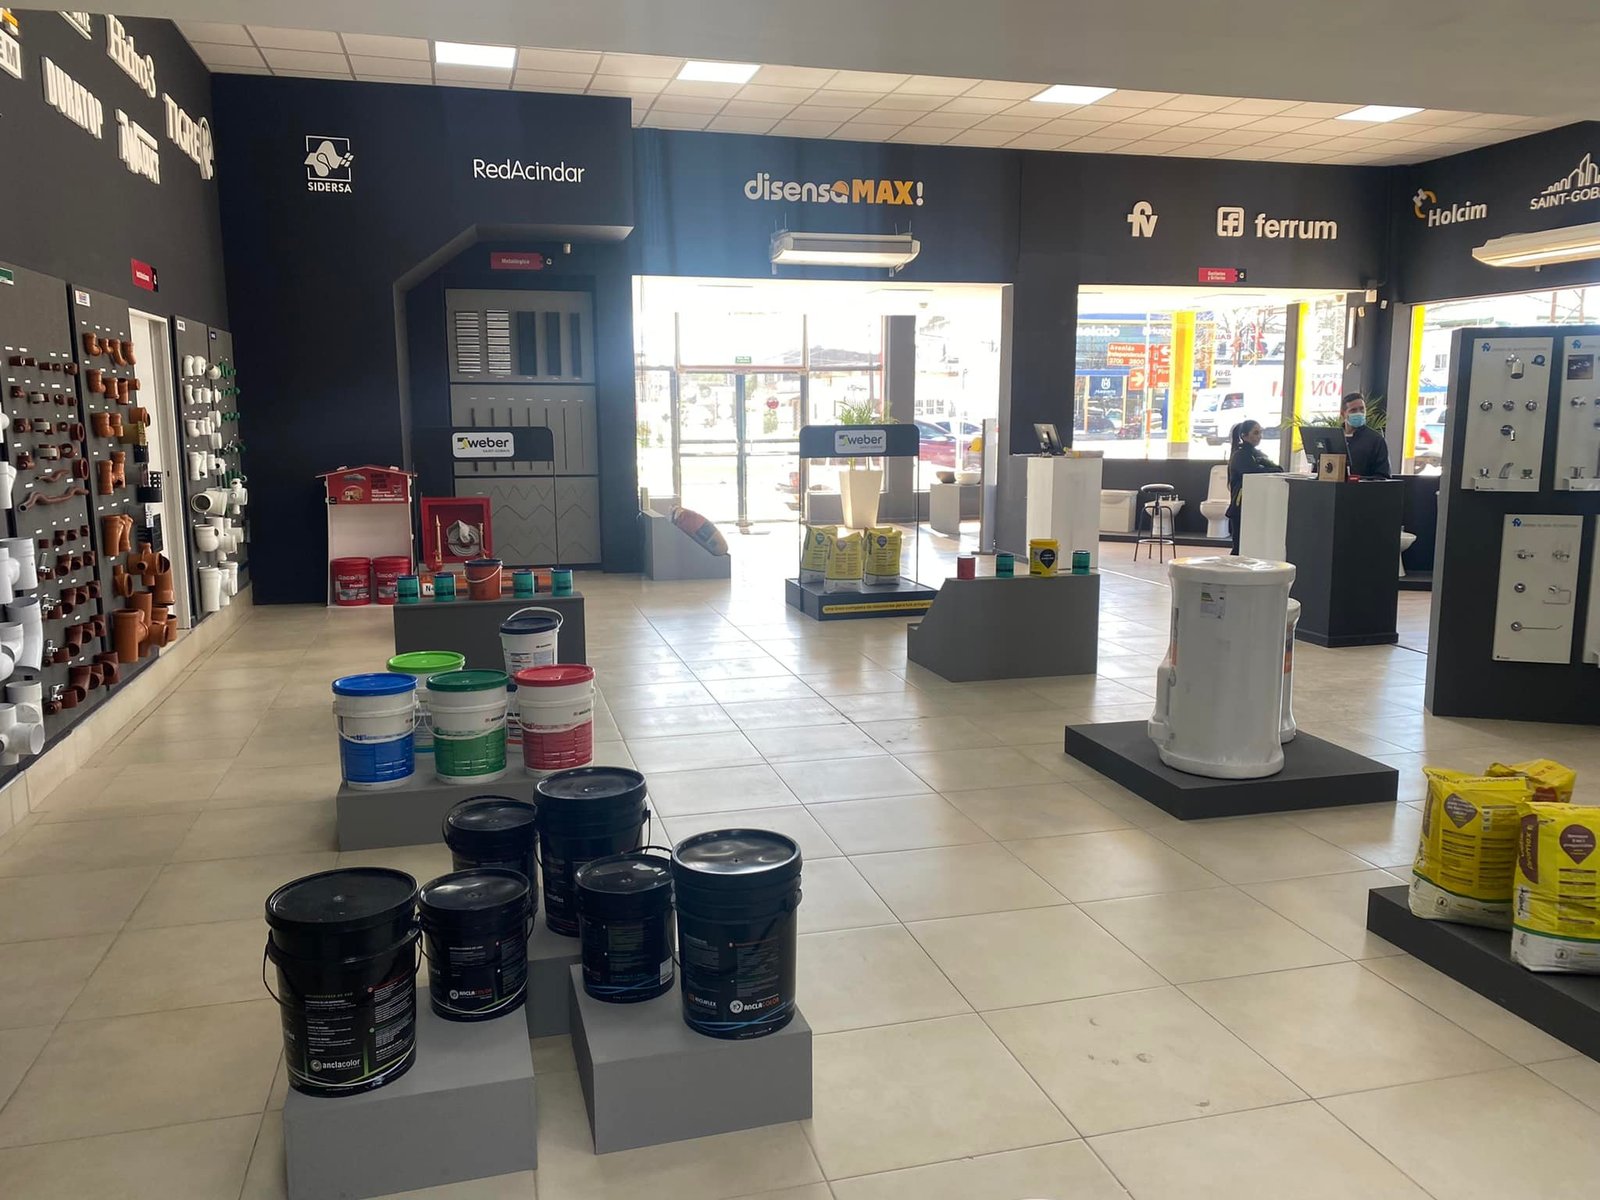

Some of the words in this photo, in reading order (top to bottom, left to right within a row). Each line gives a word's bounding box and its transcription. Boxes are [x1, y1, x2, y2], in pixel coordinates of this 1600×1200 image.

[42, 56, 104, 140] DURATOP
[162, 93, 201, 164] TIGRE
[473, 158, 585, 184] RedAcindar
[308, 182, 352, 193] SIDERSA
[1127, 200, 1159, 238] fv
[1254, 213, 1338, 240] ferrum
[1428, 201, 1488, 227] Holcim
[468, 437, 509, 448] weber
[848, 434, 882, 445] weber
[322, 1058, 361, 1070] anclacolor
